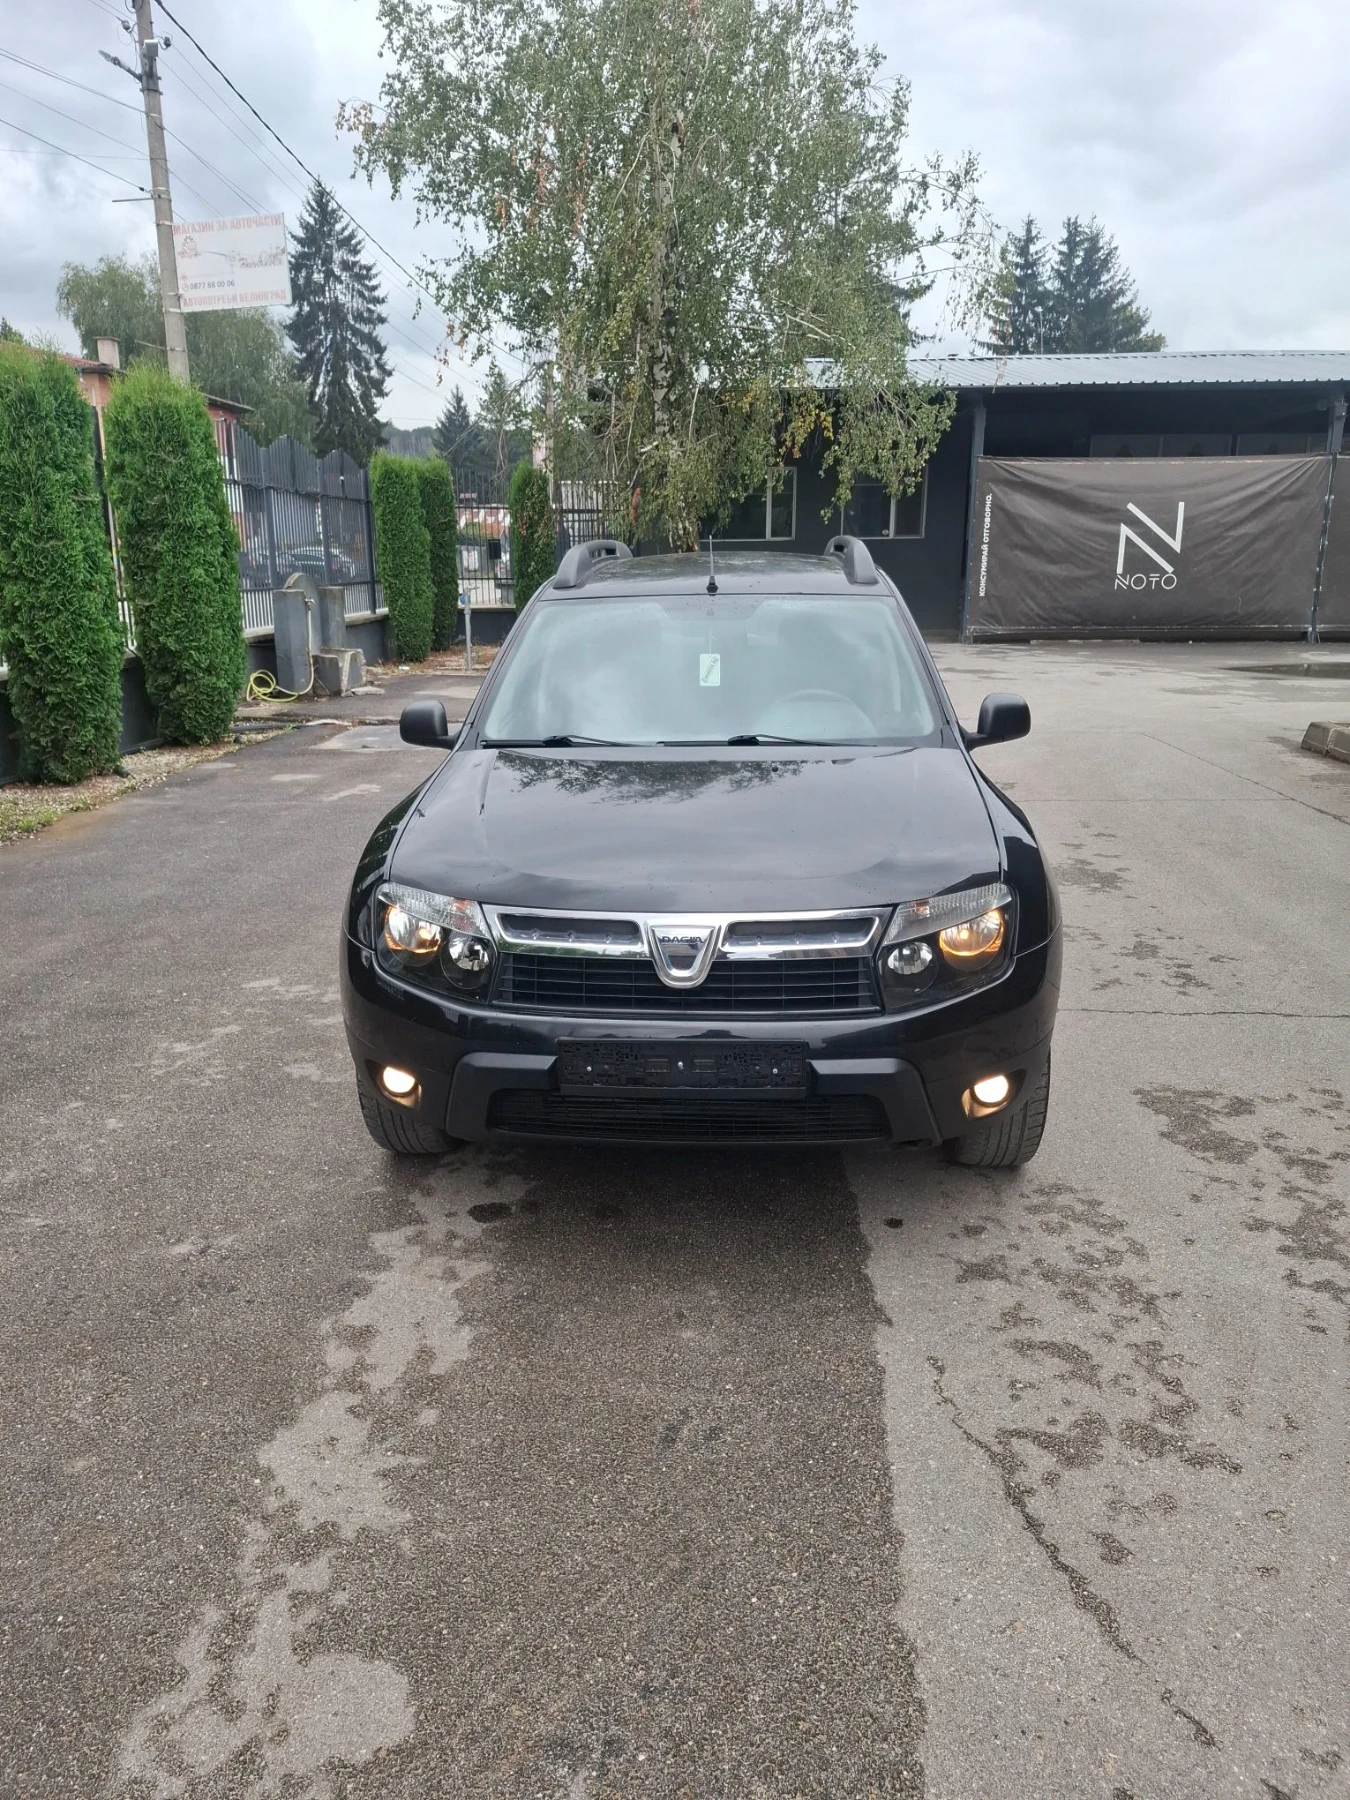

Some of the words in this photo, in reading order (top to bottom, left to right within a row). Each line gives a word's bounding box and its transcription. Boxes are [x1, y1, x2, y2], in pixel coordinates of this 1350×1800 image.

[173, 222, 214, 236] МАГАЗИН
[216, 218, 227, 230] ЗА
[230, 214, 282, 229] АВТОЧАСТИ
[983, 493, 993, 543] ОТГОВОРНО.
[978, 544, 989, 597] КОНСУМИРАЙ
[1114, 573, 1177, 590] NOTO
